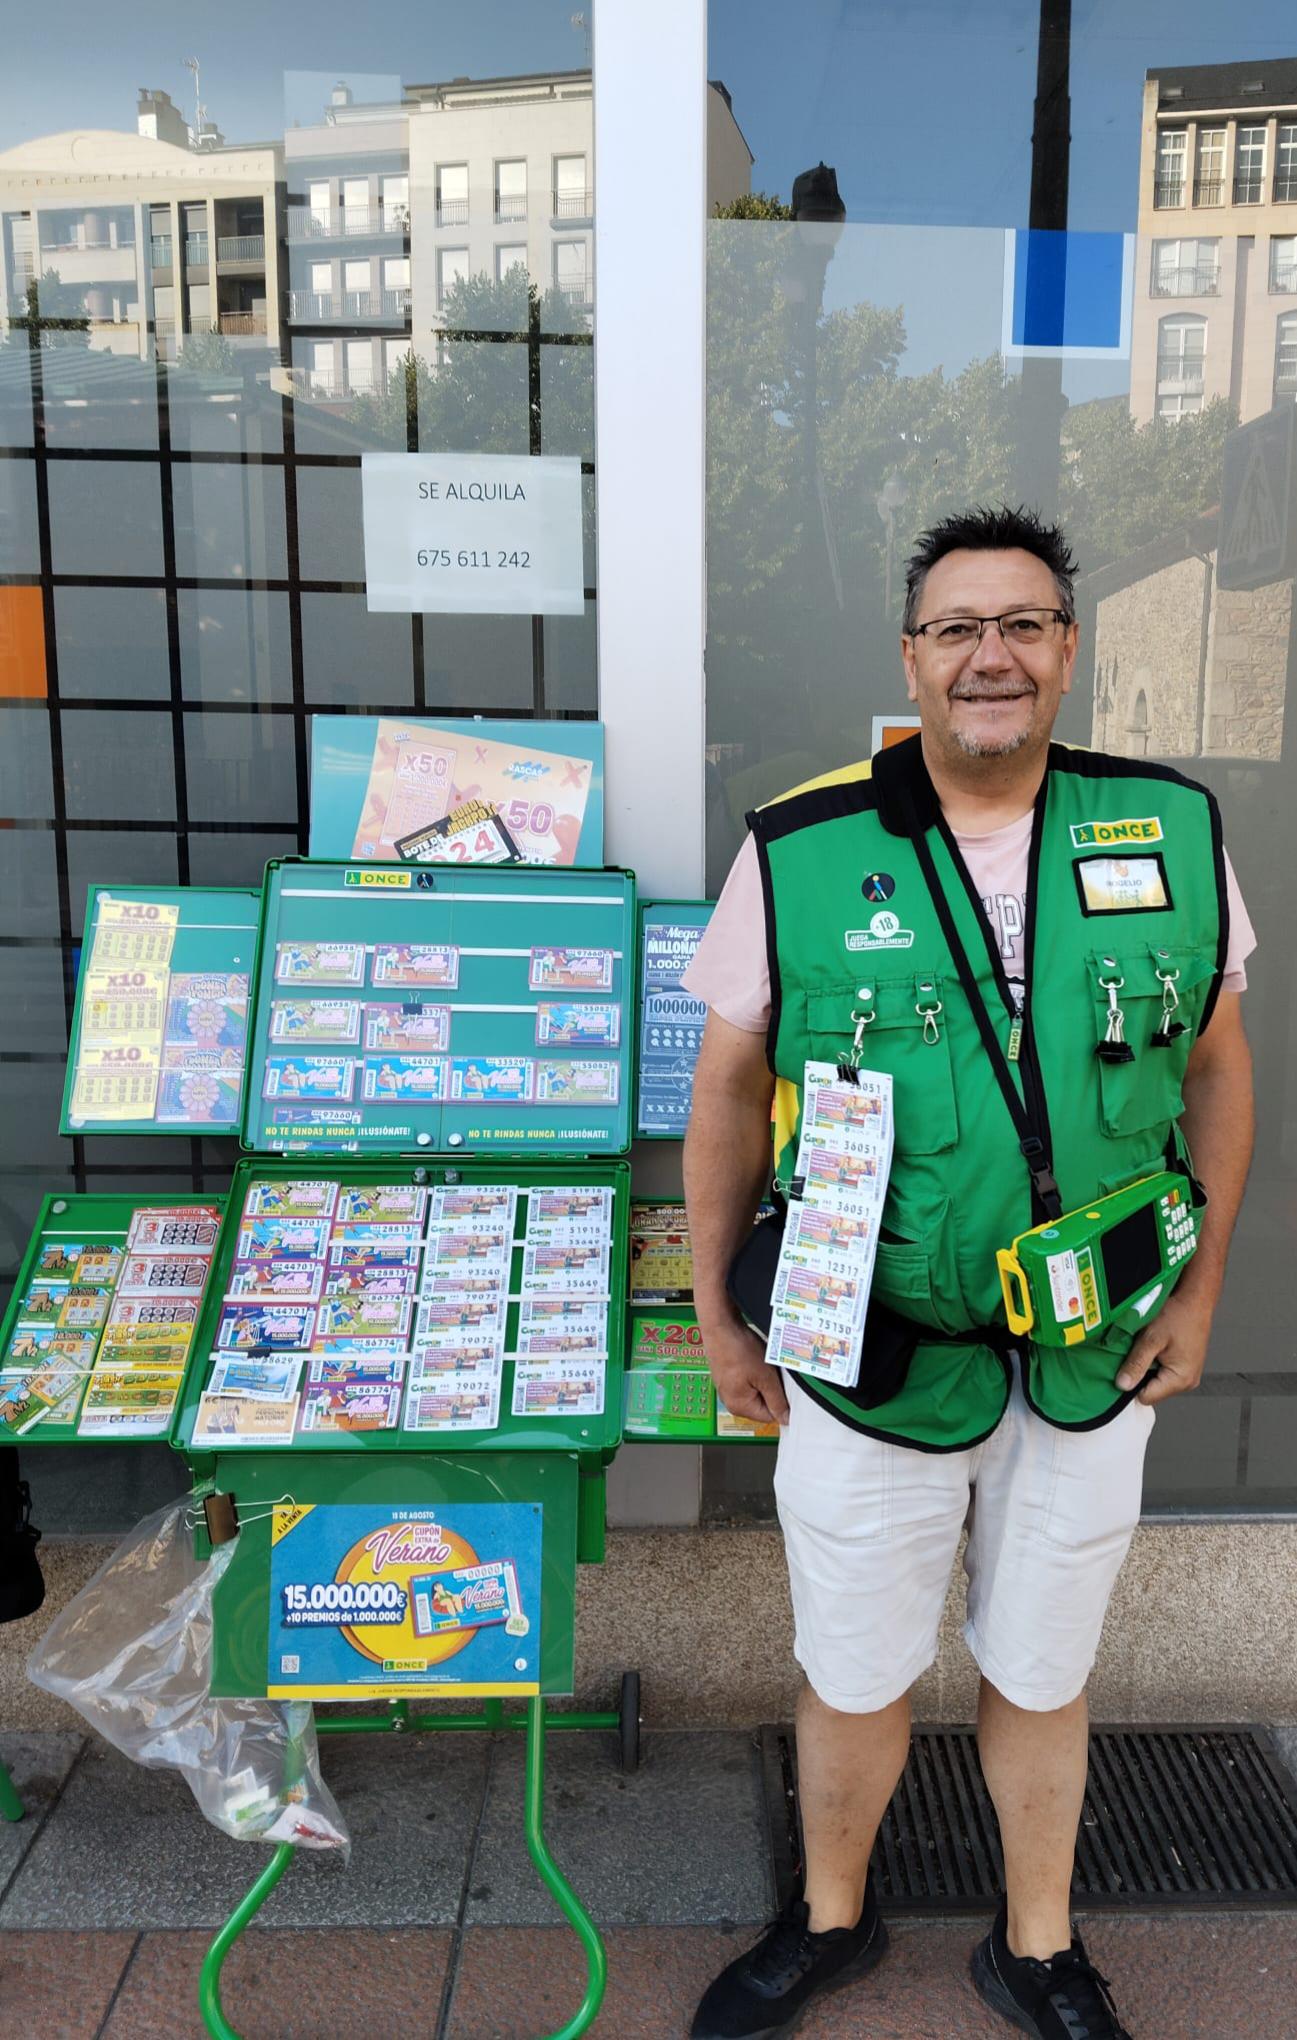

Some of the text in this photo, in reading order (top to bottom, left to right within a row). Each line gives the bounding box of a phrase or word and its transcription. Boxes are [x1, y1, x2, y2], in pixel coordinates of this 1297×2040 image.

[418, 482, 526, 501] SE ALQUILA
[417, 550, 531, 568] 675 611 242
[1098, 823, 1155, 840] ONCE
[364, 874, 407, 885] ONCE
[667, 926, 699, 941] Mega
[849, 938, 909, 948] RESPONSABLEMENTE
[107, 973, 146, 987] x10
[648, 997, 705, 1015] 1000000
[1009, 1030, 1019, 1057] ONCE
[102, 1047, 141, 1061] x10
[850, 1082, 880, 1094] 6051
[265, 1127, 277, 1136] NO
[280, 1127, 289, 1136] TE
[292, 1127, 323, 1136] RINDAS
[326, 1127, 355, 1136] NUNCA
[468, 1130, 479, 1138] NO
[483, 1130, 492, 1138] TE
[494, 1130, 525, 1139] RINDAS
[527, 1130, 556, 1139] NUNCA
[844, 1140, 877, 1155] 36051
[837, 1200, 870, 1217] 36051
[827, 1261, 859, 1276] 12317
[566, 1280, 598, 1288] 35649
[1081, 1273, 1097, 1322] ONCE
[818, 1317, 852, 1335] 75150
[561, 1370, 595, 1378] 35649
[400, 1511, 408, 1519] DE
[409, 1511, 435, 1519] AGOSTO
[414, 1525, 440, 1536] CUPÓN
[367, 1525, 451, 1571] Verano
[468, 1564, 500, 1579] 00000
[284, 1583, 406, 1609] 15.000.000€
[461, 1580, 505, 1609] Verano
[286, 1612, 402, 1623] +10 PREMIOS de 1.000.000€
